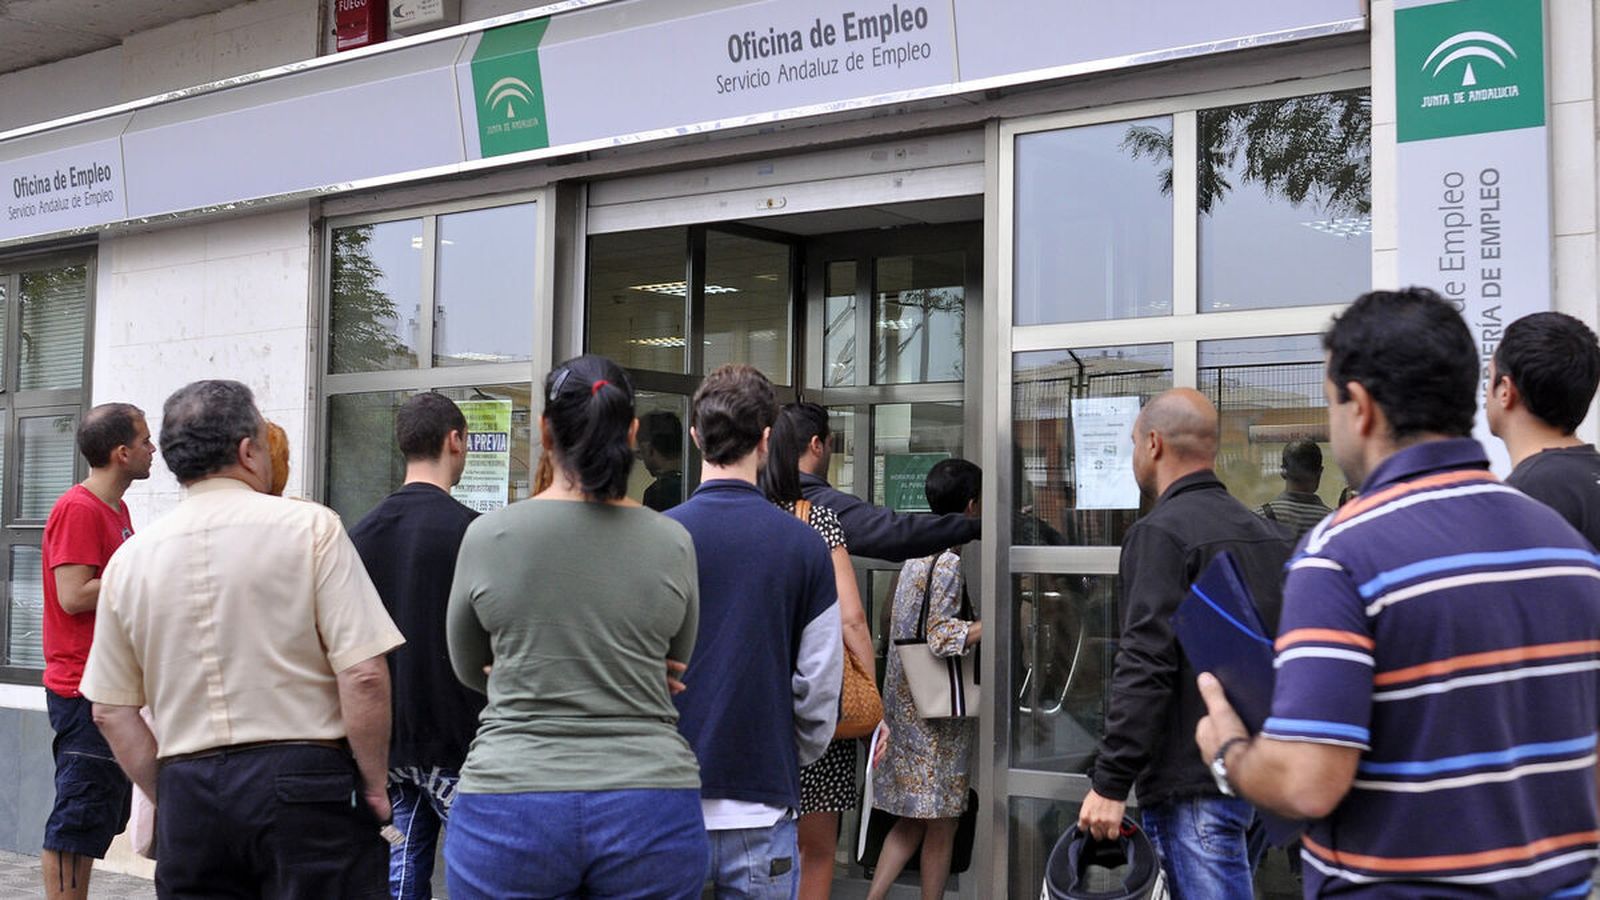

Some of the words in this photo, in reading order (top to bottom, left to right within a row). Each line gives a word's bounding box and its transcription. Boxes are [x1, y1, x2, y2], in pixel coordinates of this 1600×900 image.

[339, 0, 367, 12] FUEGO
[728, 27, 803, 63] Oficina
[809, 18, 836, 49] de
[842, 3, 928, 43] Empleo
[716, 68, 770, 94] Servicio
[777, 59, 839, 84] Andaluz
[846, 53, 864, 72] de
[872, 41, 931, 68] Empleo
[1421, 94, 1450, 108] JUNTA
[1453, 91, 1466, 104] DE
[13, 174, 51, 199] Oficina
[53, 170, 67, 191] de
[69, 162, 112, 189] Empleo
[8, 202, 36, 221] Servicio
[39, 197, 69, 214] Andaluz
[71, 193, 81, 208] de
[84, 189, 114, 207] Empleo
[1438, 171, 1472, 272] Empleo
[1479, 167, 1501, 260] EMPLEO
[1481, 267, 1502, 298] DE
[474, 433, 506, 451] PREVIA
